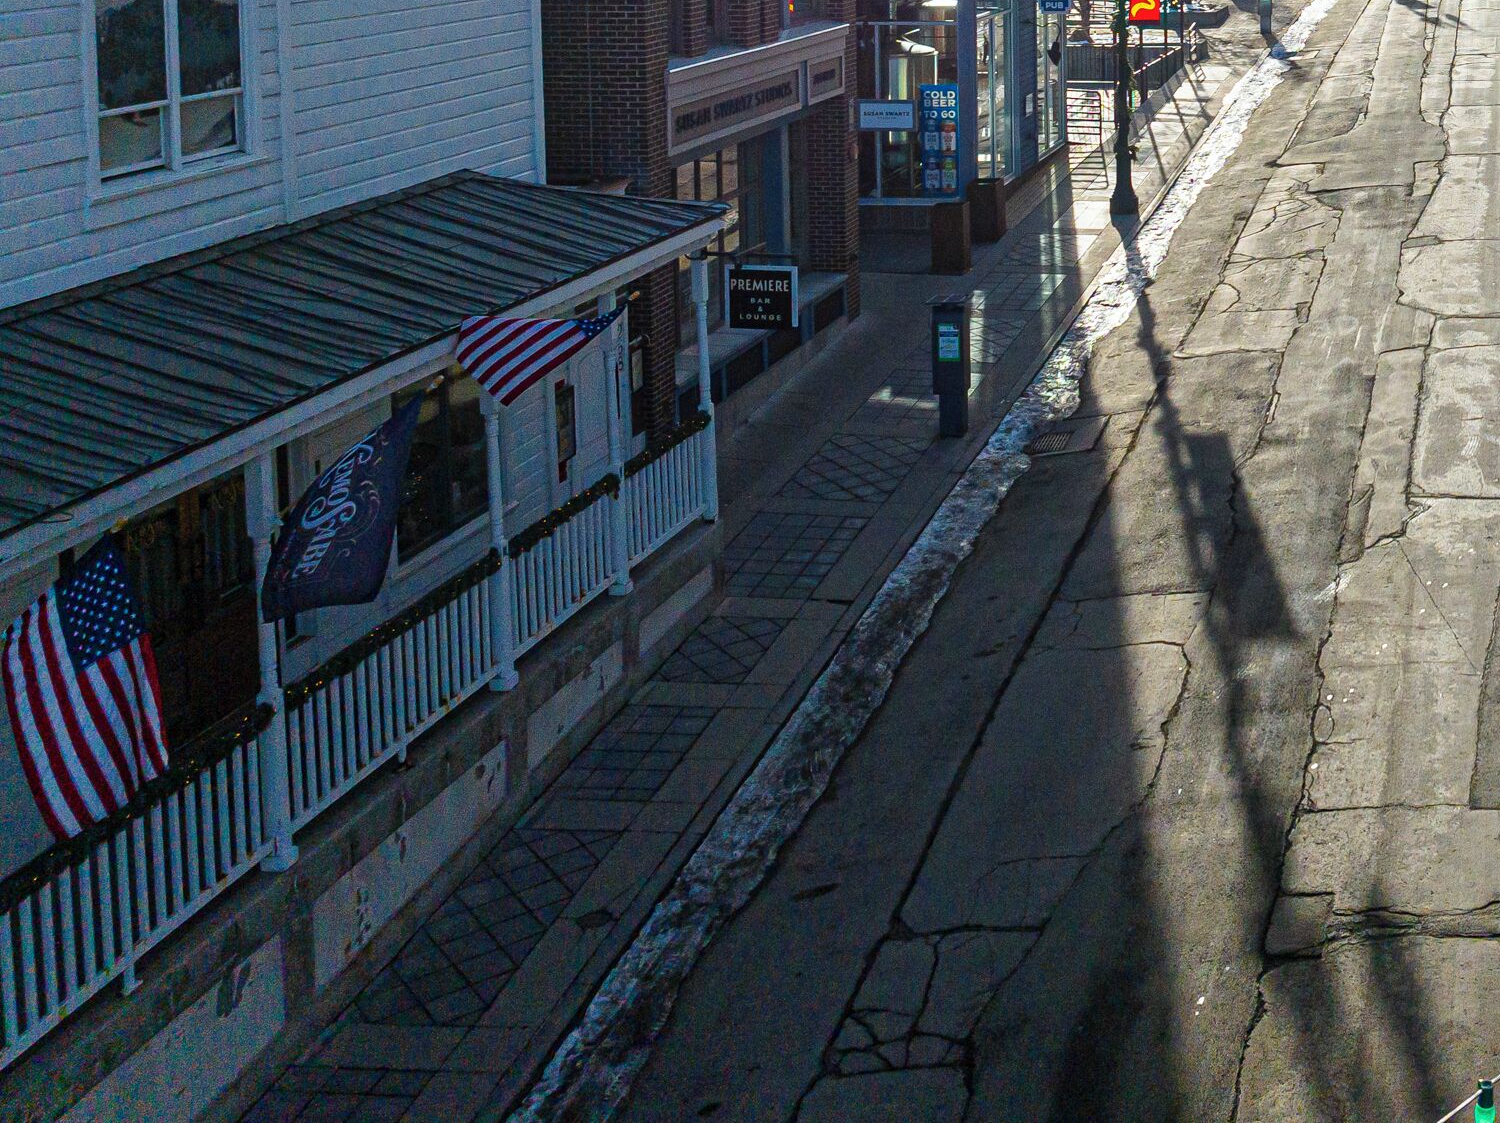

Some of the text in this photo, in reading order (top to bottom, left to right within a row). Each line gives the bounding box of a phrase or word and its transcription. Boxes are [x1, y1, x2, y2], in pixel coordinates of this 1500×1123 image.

[1045, 1, 1064, 9] PUB
[924, 90, 956, 99] COLD
[924, 99, 956, 107] BEER
[924, 110, 956, 118] TO GO
[730, 278, 790, 292] PREMIERE
[739, 313, 782, 321] LOUNGE
